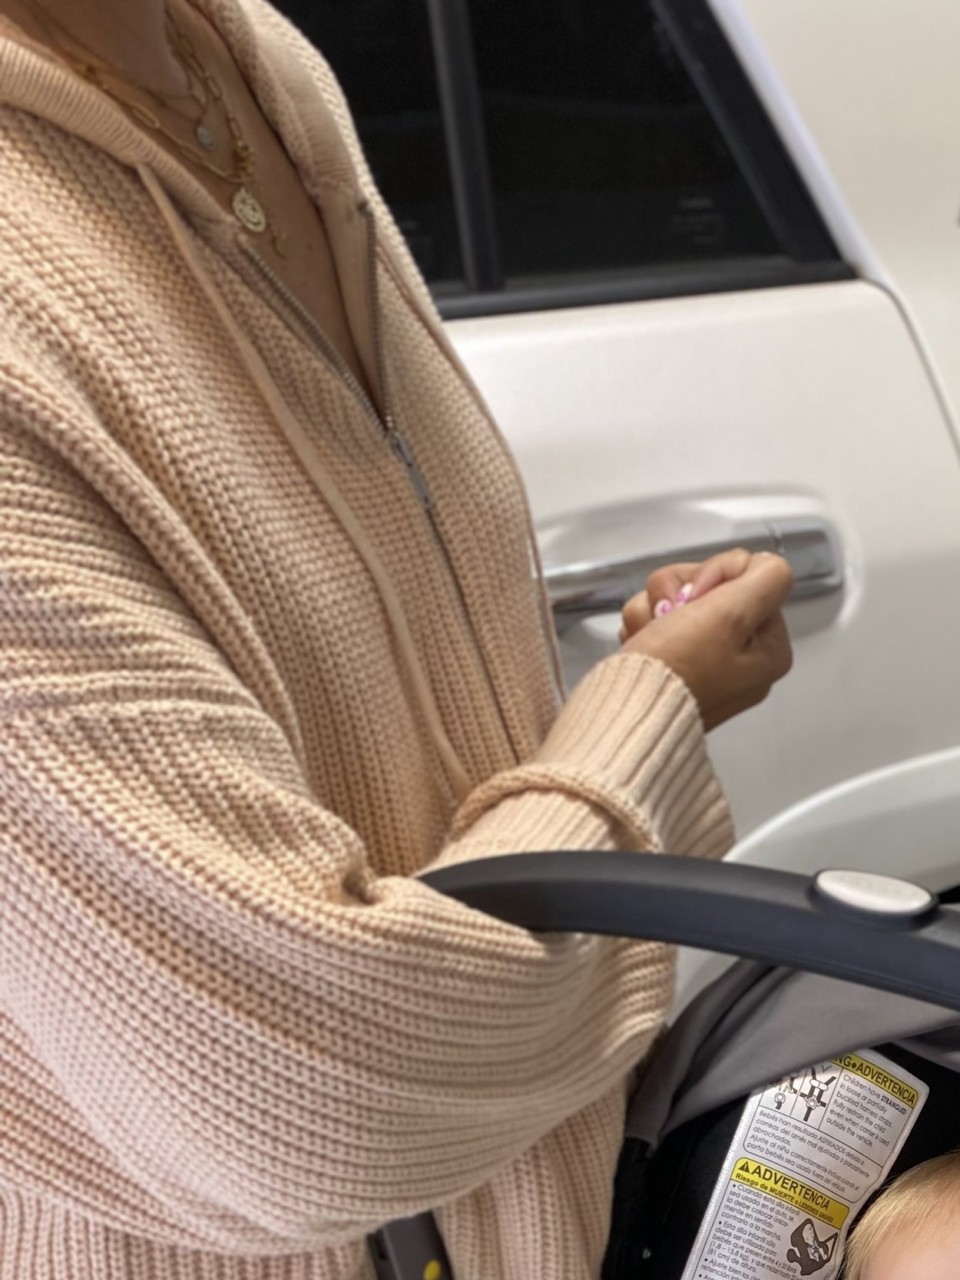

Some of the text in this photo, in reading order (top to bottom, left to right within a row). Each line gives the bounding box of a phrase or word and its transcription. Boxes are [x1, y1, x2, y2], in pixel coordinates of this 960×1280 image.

[854, 1059, 919, 1105] ADVERTENCIA
[734, 1172, 759, 1188] Riesgo
[768, 1186, 794, 1202] MUERTE
[736, 1183, 763, 1200] Cuando
[749, 1162, 832, 1210] ADVERTENCIA
[732, 1198, 751, 1211] debe
[714, 1225, 733, 1238] debe
